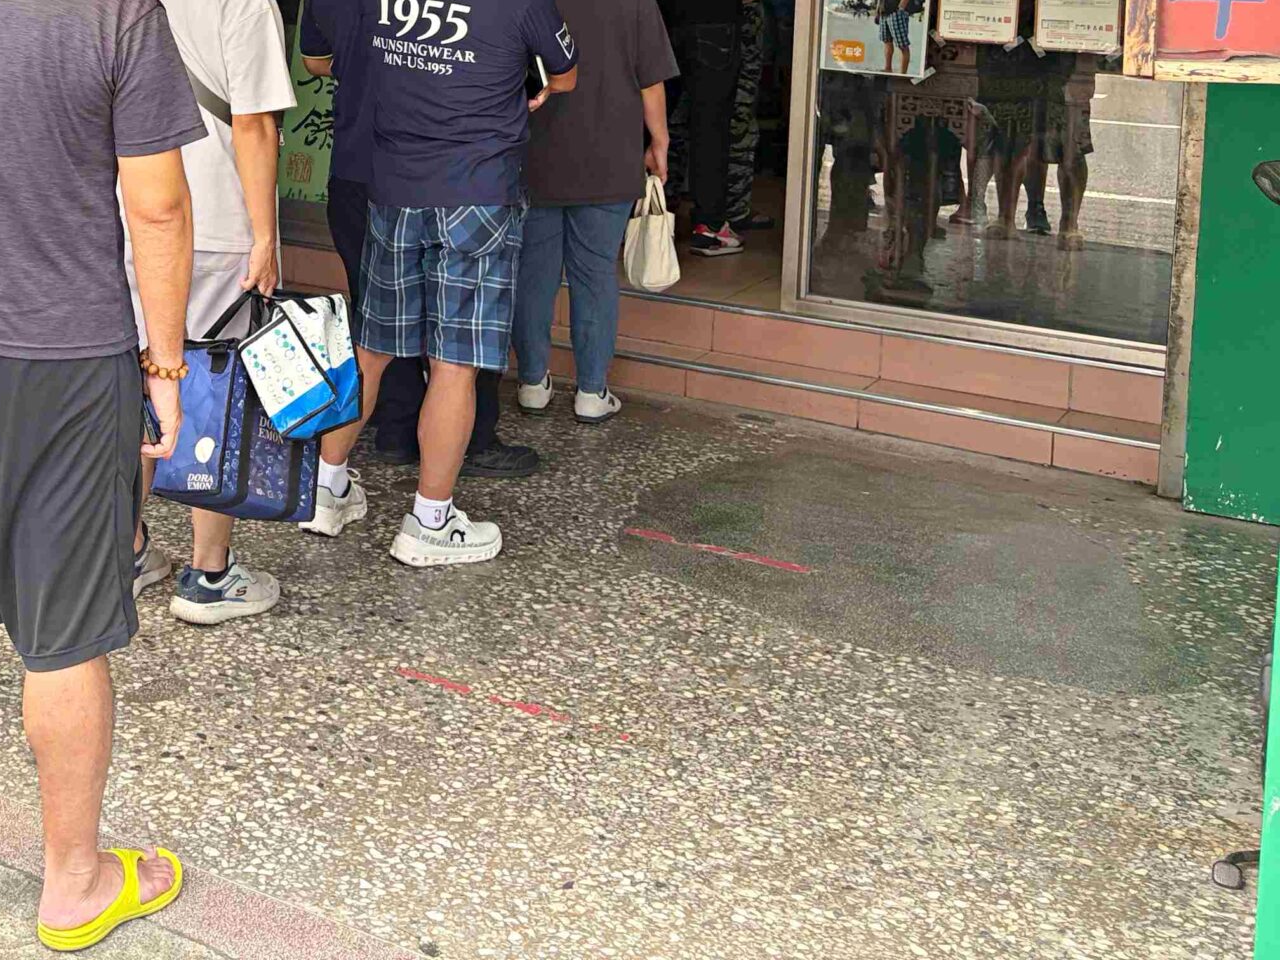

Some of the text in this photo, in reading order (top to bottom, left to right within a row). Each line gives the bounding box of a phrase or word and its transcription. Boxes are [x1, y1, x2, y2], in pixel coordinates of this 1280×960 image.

[372, 35, 476, 63] MUNSINGWEAR
[383, 52, 453, 75] MN-US.1955
[187, 472, 214, 482] DORA
[187, 480, 213, 490] EMON
